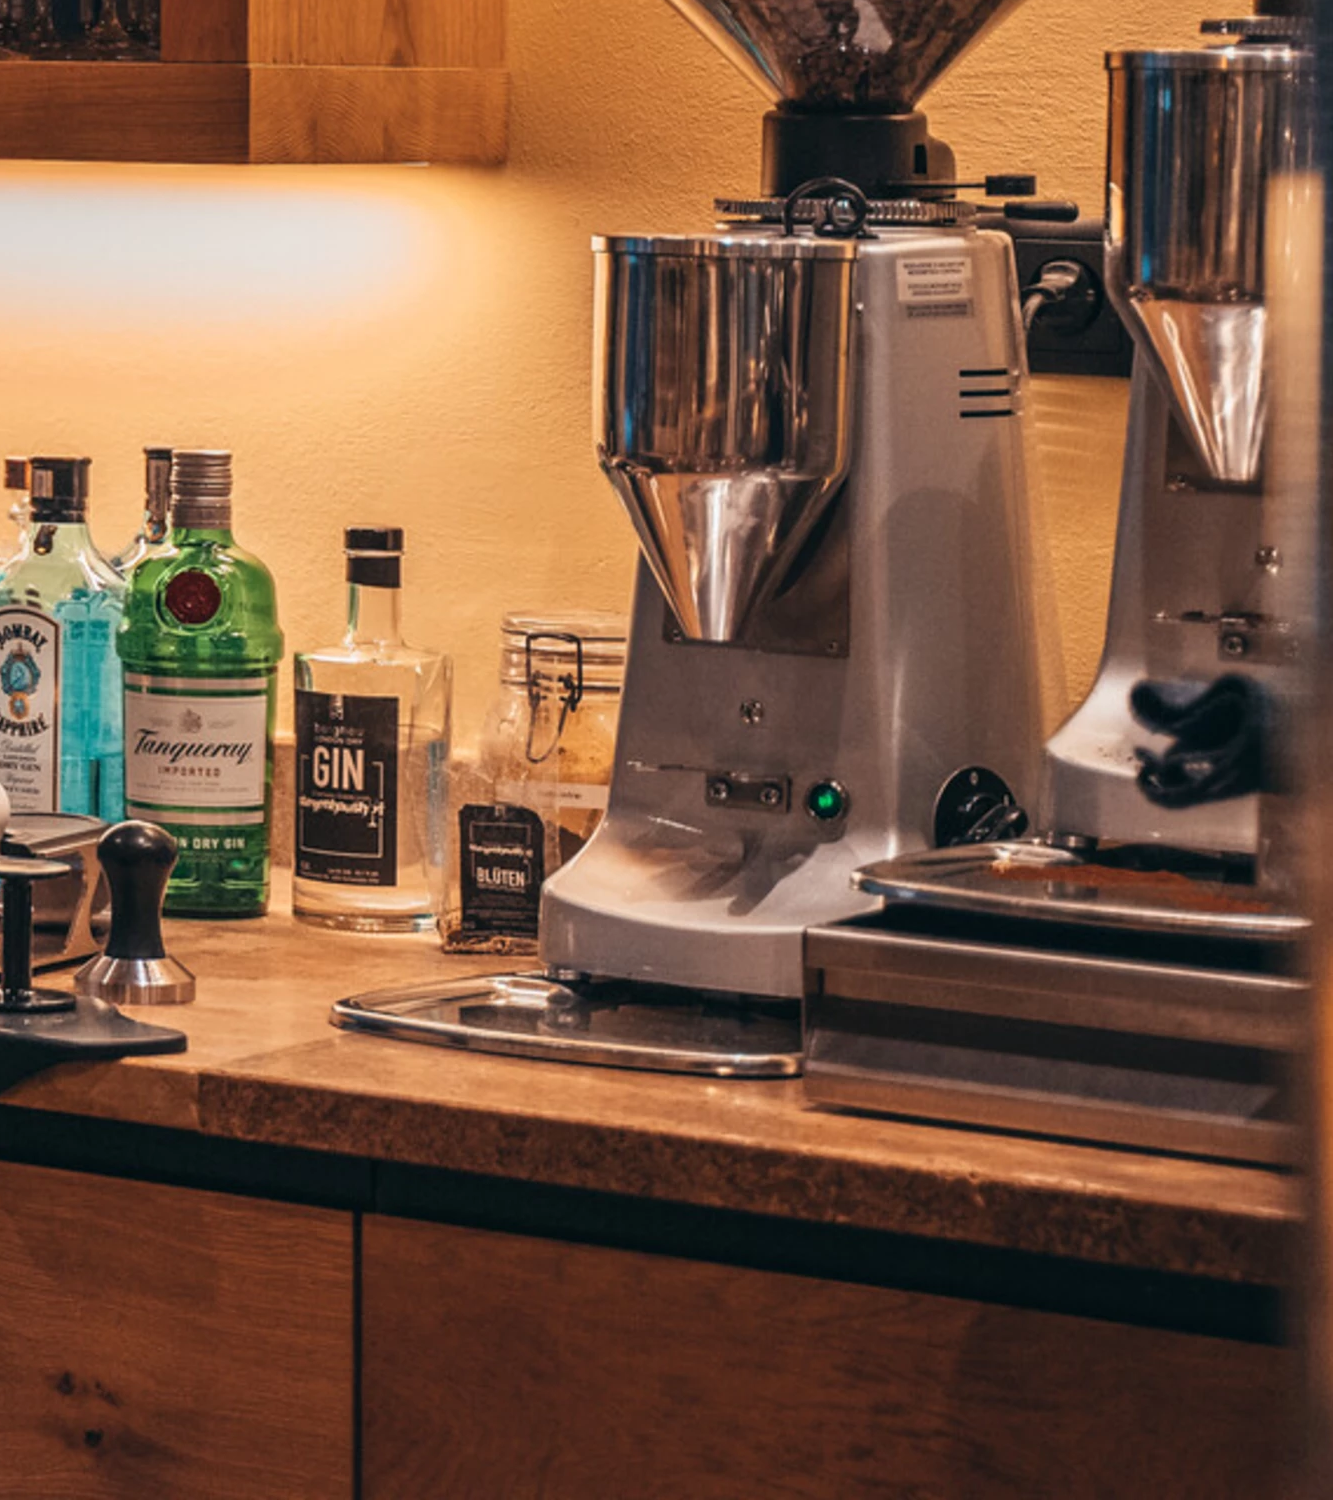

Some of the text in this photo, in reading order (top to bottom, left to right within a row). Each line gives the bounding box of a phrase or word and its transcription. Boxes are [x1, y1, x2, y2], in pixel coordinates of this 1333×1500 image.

[134, 728, 253, 765] Tanqueray
[158, 766, 221, 777] IMPORTED
[313, 745, 365, 791] GIN
[193, 837, 219, 849] DRY
[223, 837, 245, 850] GIN
